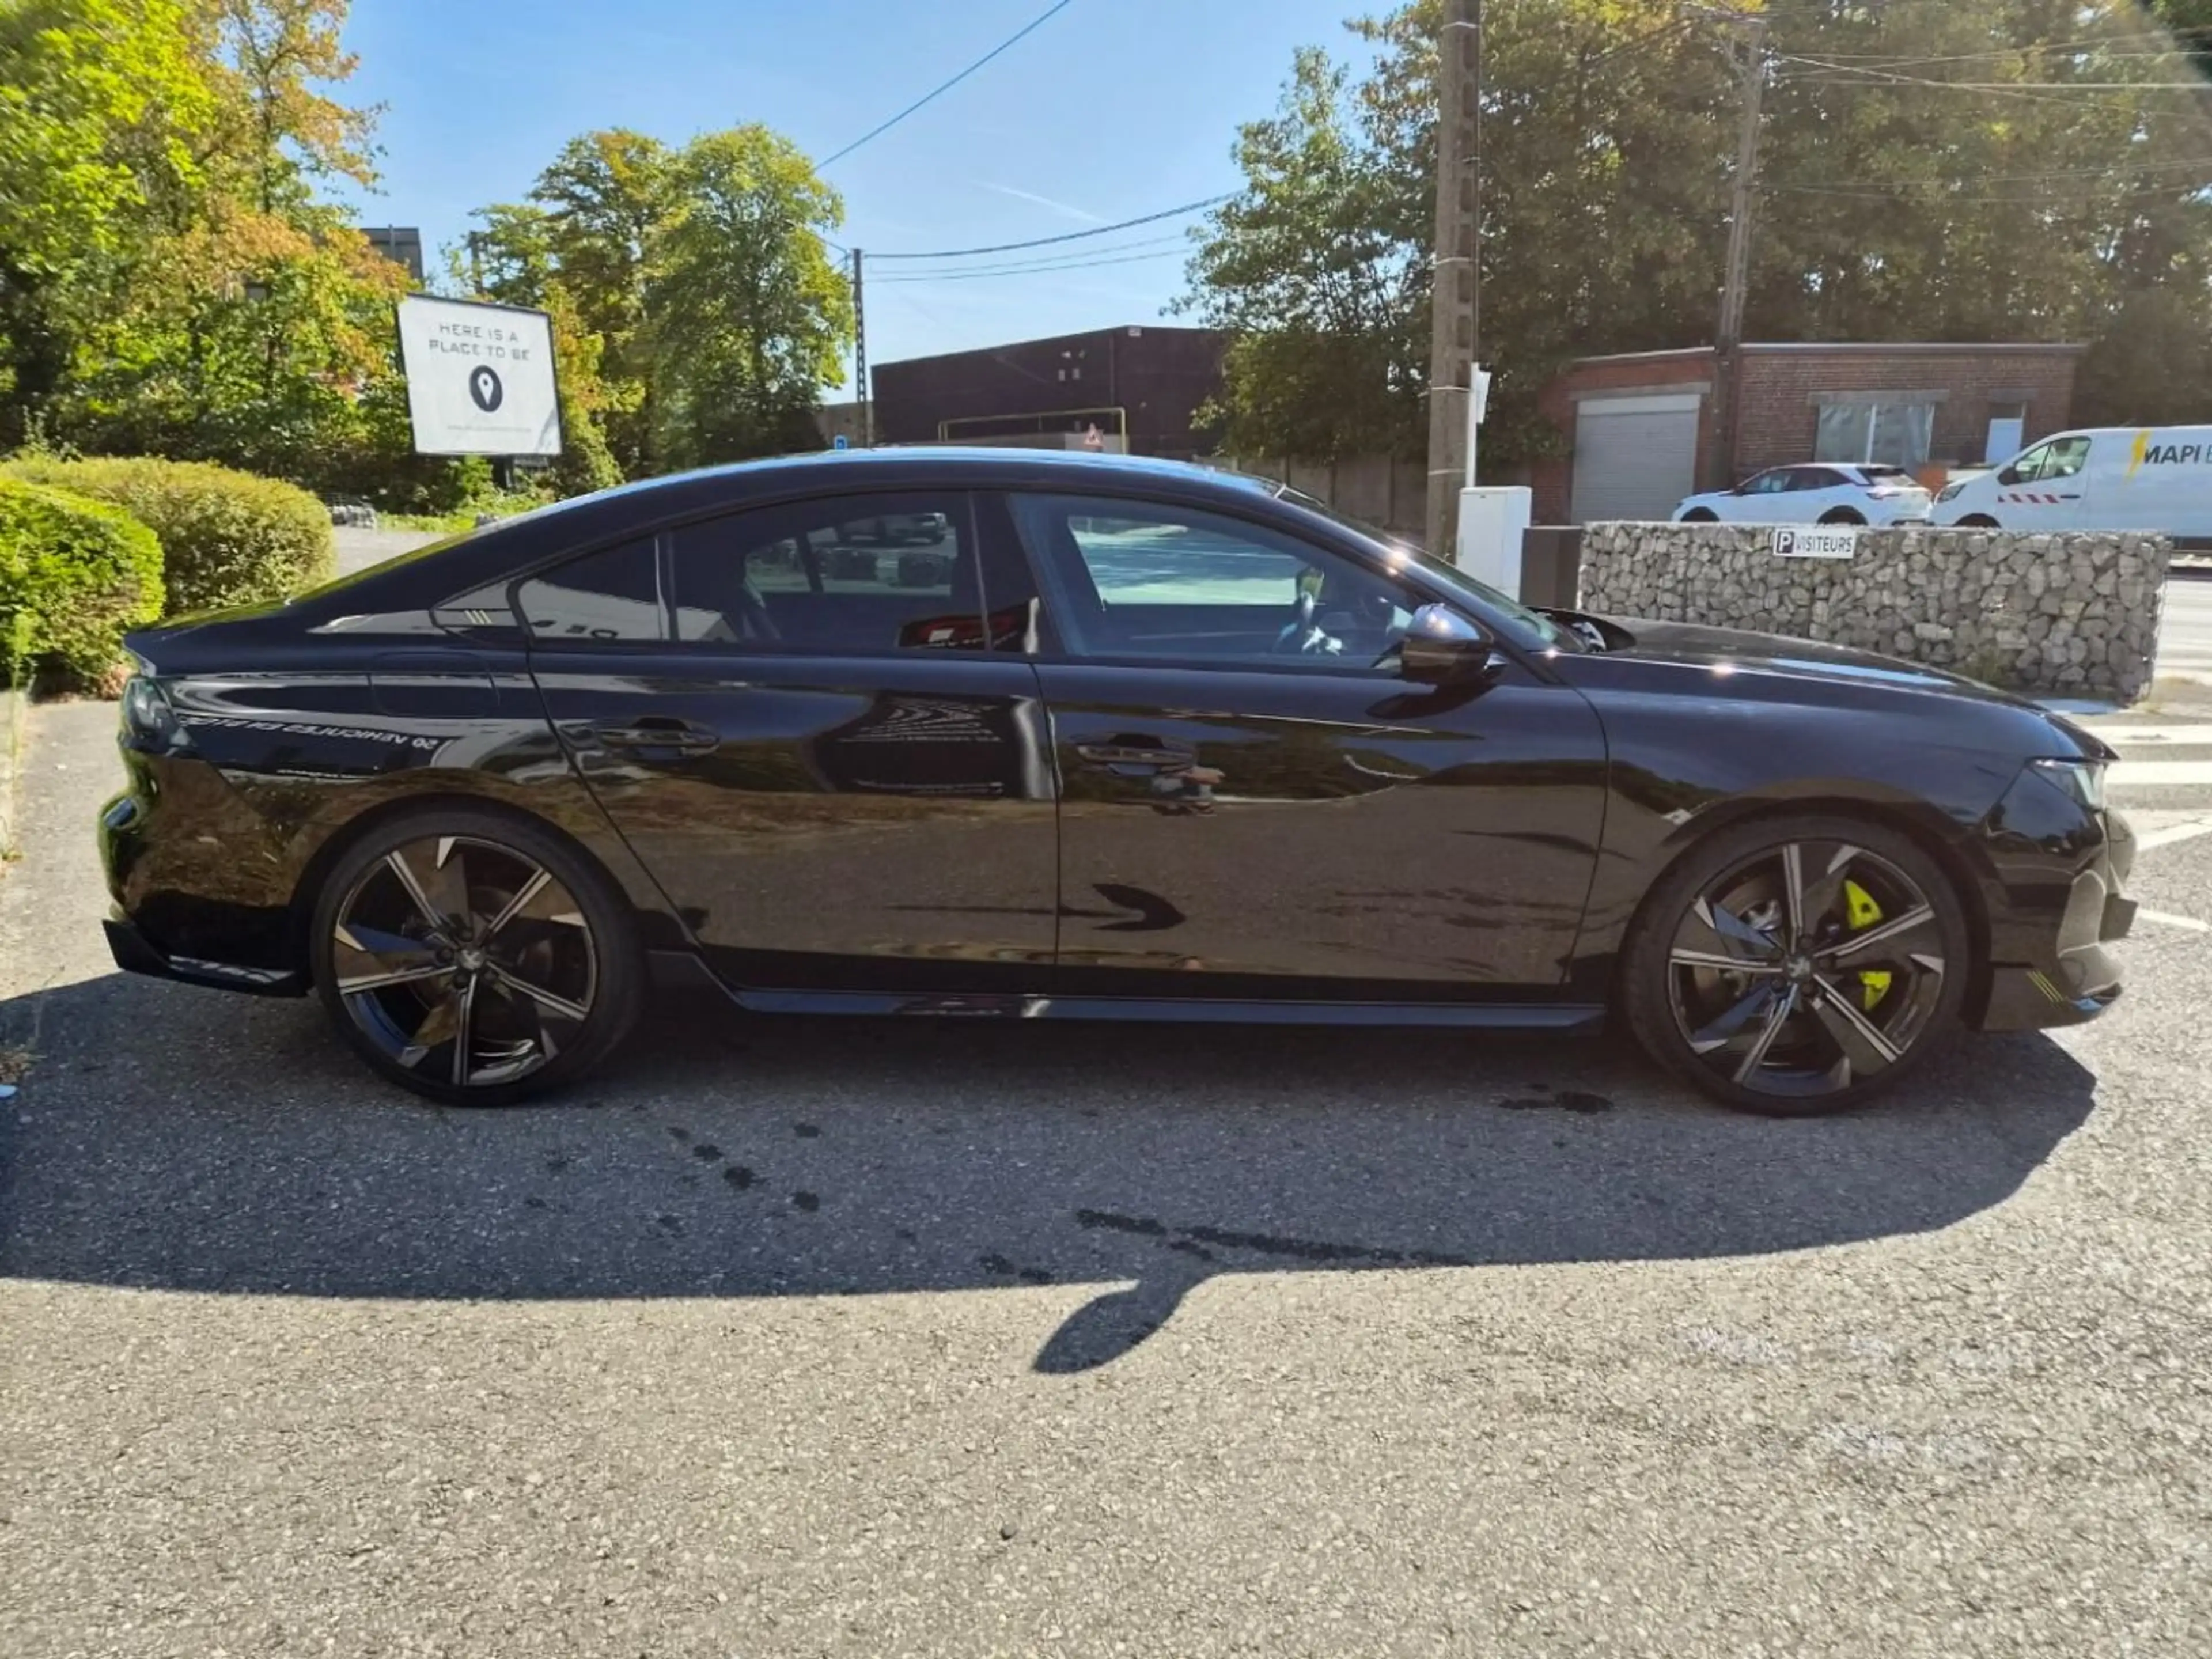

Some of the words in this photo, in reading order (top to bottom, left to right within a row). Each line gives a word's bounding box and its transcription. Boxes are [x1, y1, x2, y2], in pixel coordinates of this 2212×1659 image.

[440, 324, 483, 338] HERE
[488, 328, 503, 341] IS
[509, 332, 518, 342] A
[429, 339, 480, 356] PLACE
[487, 344, 506, 358] TO
[512, 349, 530, 361] BE
[1796, 535, 1853, 552] VISITEURS
